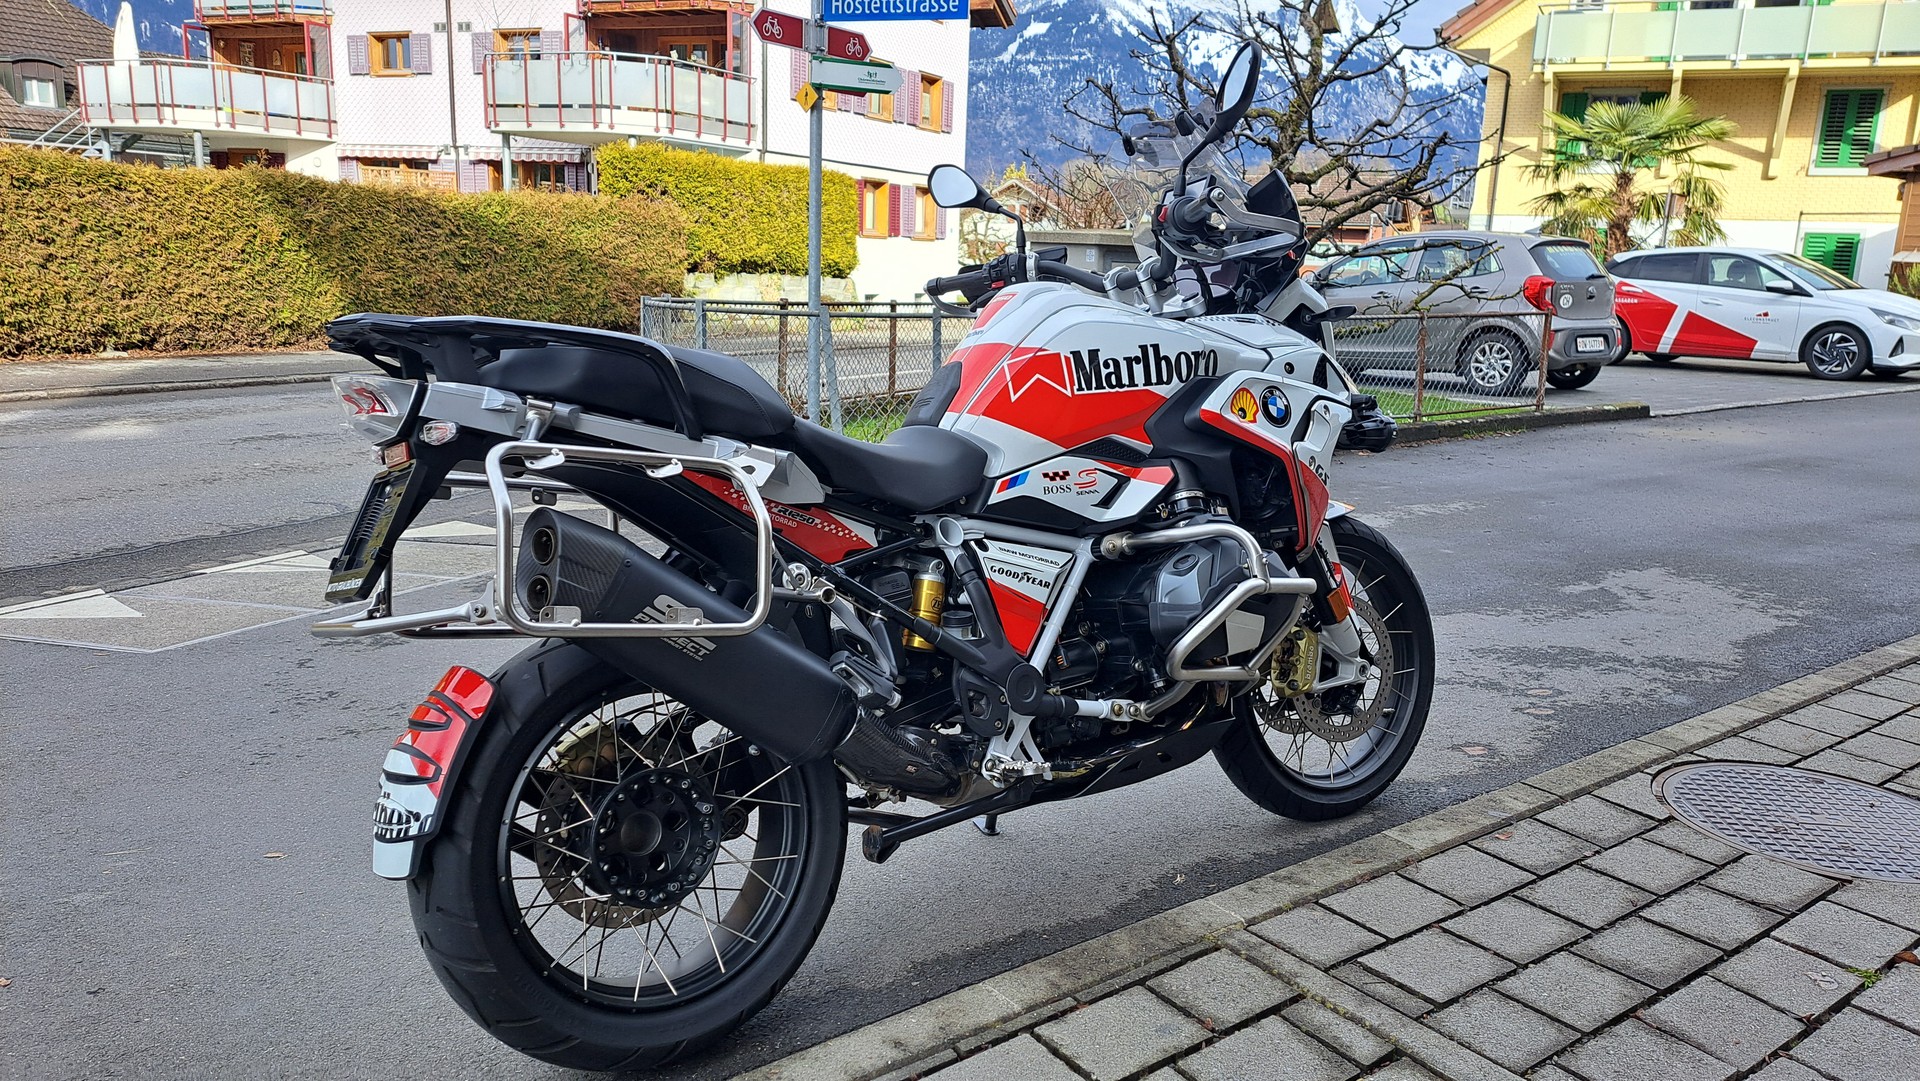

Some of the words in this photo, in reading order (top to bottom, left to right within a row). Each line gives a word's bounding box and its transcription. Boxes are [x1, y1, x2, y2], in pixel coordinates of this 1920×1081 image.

[831, 0, 959, 14] Hostettstrasse
[1069, 343, 1218, 392] Marlboro
[1043, 484, 1072, 495] BOSS
[776, 506, 816, 526] R1250
[1304, 645, 1315, 680] brembo
